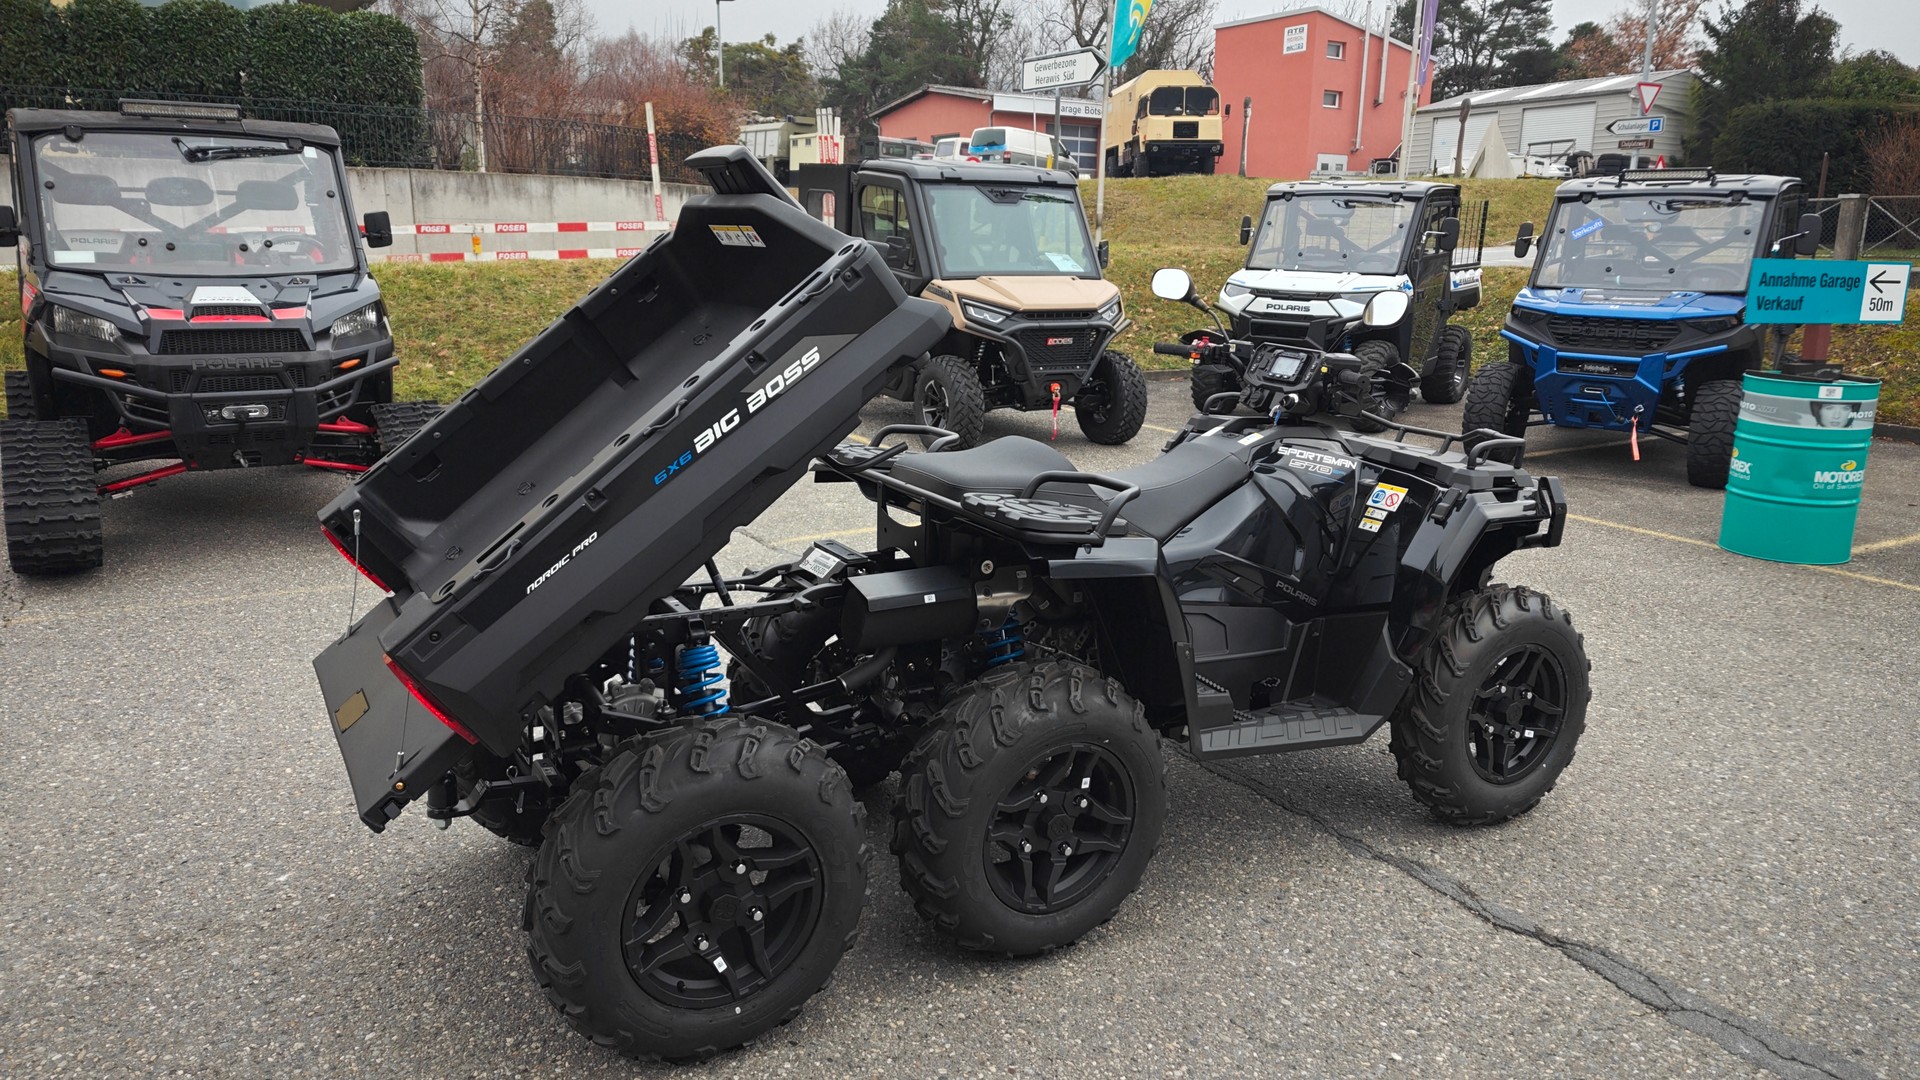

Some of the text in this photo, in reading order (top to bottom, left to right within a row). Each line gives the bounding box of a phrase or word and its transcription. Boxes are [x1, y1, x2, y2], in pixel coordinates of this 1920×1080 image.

[1034, 58, 1077, 73] Gewerbezone
[1035, 70, 1075, 85] Herawis Süd
[1060, 105, 1103, 116] arage Böts
[1652, 120, 1659, 129] P
[420, 225, 447, 233] FOSER
[496, 224, 526, 232] FOSER
[617, 222, 643, 230] FOSER
[70, 237, 118, 245] POLARIS
[498, 252, 527, 260] FOSER
[1759, 272, 1861, 292] Annahme Garage
[1266, 303, 1311, 312] POLARIS
[1756, 295, 1805, 311] Verkauf
[1869, 297, 1894, 312] 50m
[1569, 325, 1651, 339] POLARIS
[191, 357, 284, 370] POLARIS
[693, 407, 741, 454] BIG
[746, 345, 821, 414] BOSS
[1277, 446, 1358, 470] SPORTSMAN
[1288, 458, 1333, 475] 570
[526, 531, 598, 595] NORDIC PRO
[1275, 580, 1318, 607] POLARIS
